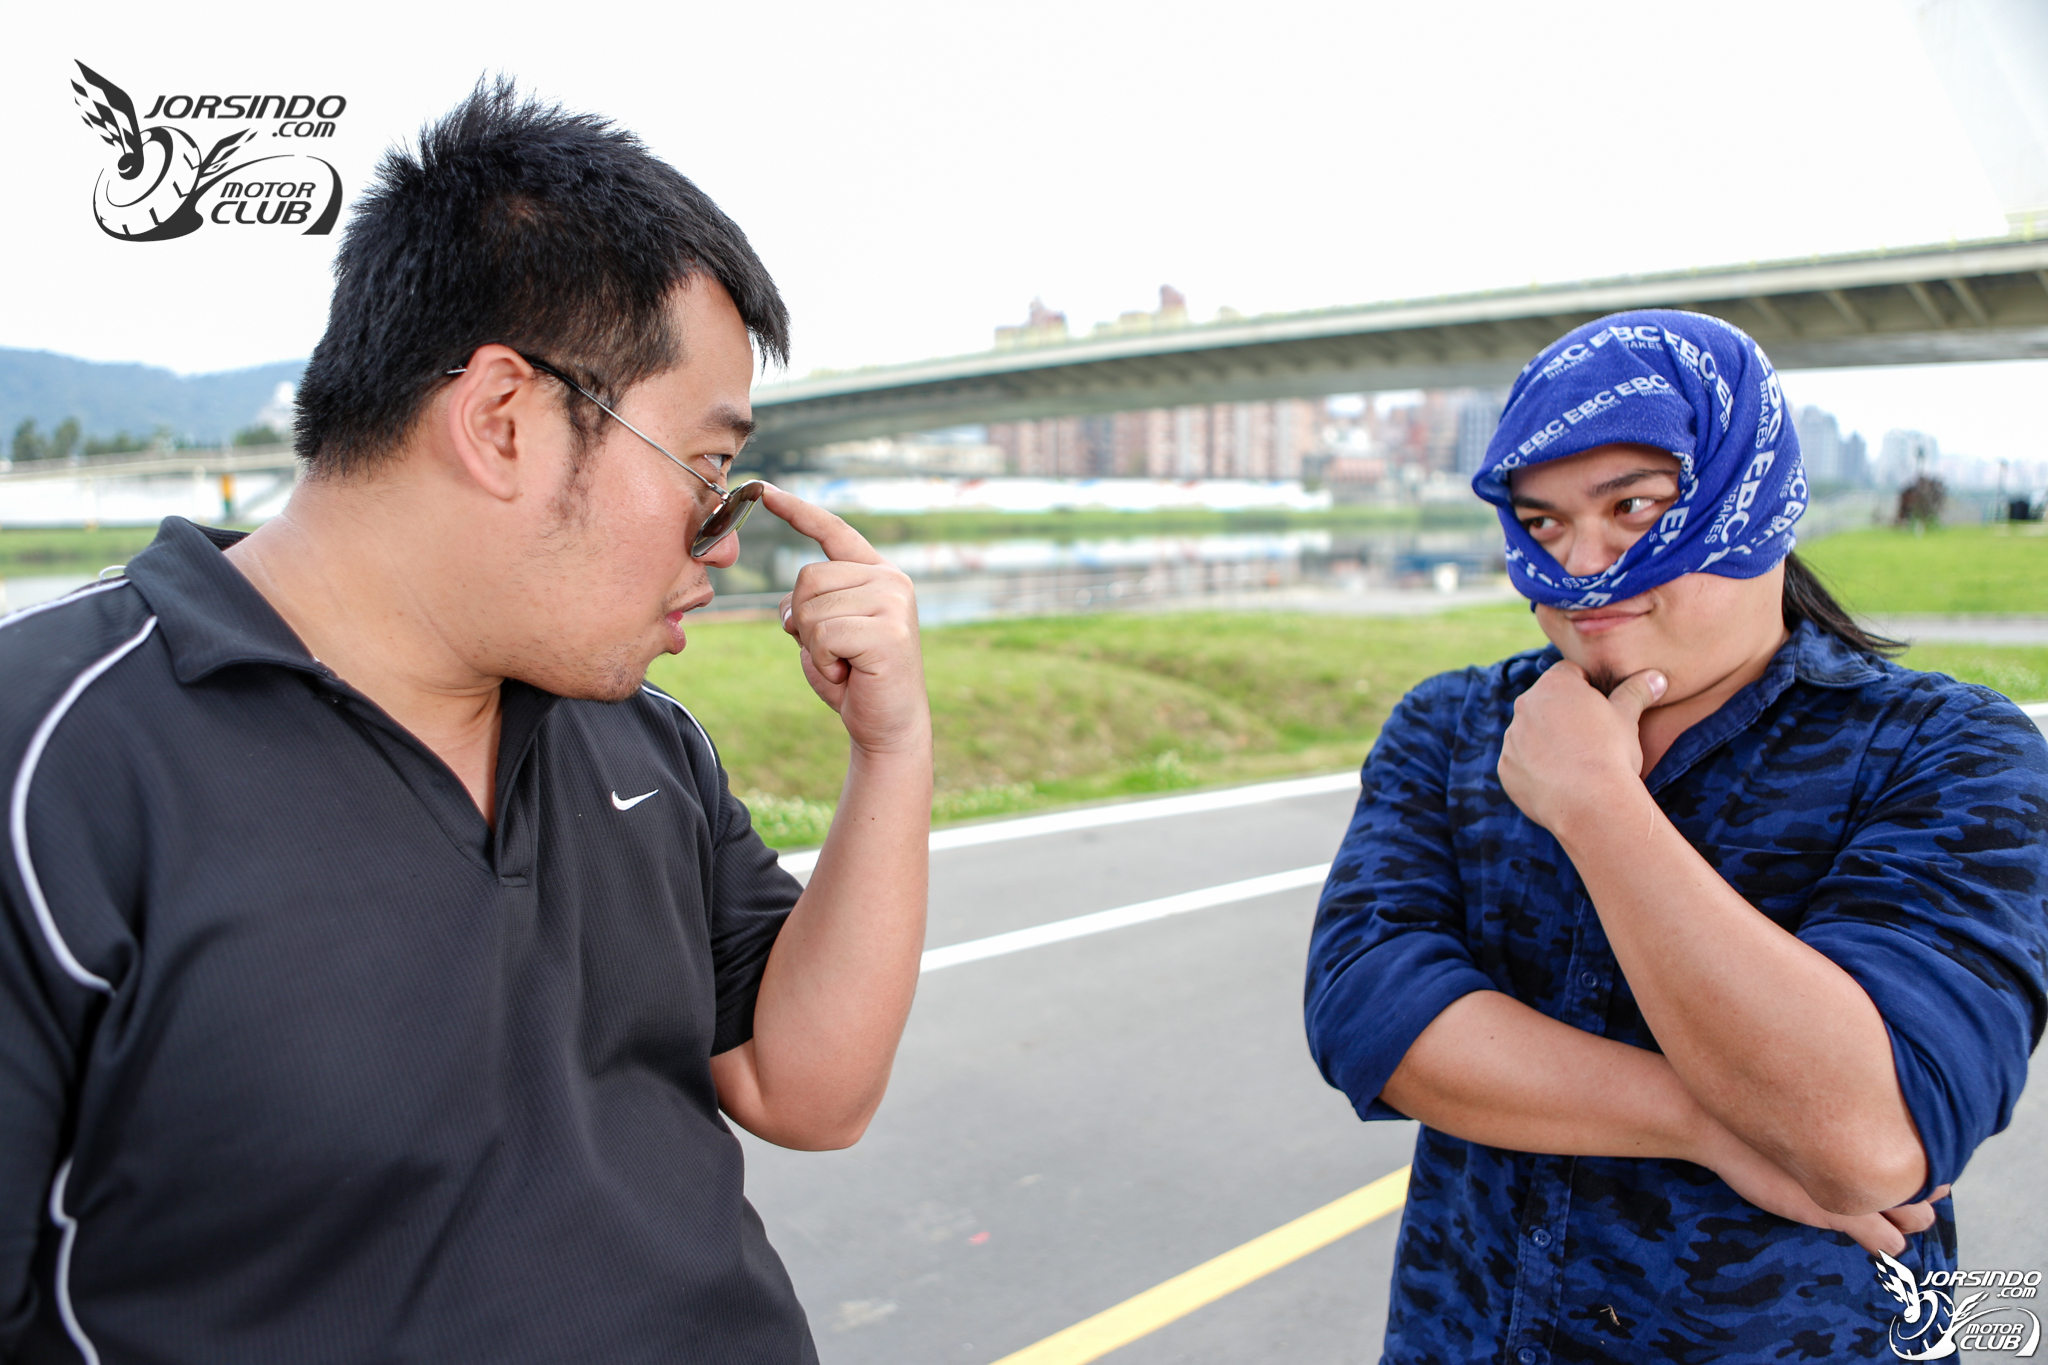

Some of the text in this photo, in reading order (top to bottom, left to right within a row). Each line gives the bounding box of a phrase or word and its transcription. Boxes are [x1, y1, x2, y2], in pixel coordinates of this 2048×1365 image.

[1518, 374, 1670, 457] EBC EBC EBC
[1755, 379, 1770, 449] BRAKES
[1704, 485, 1740, 544] RAKES
